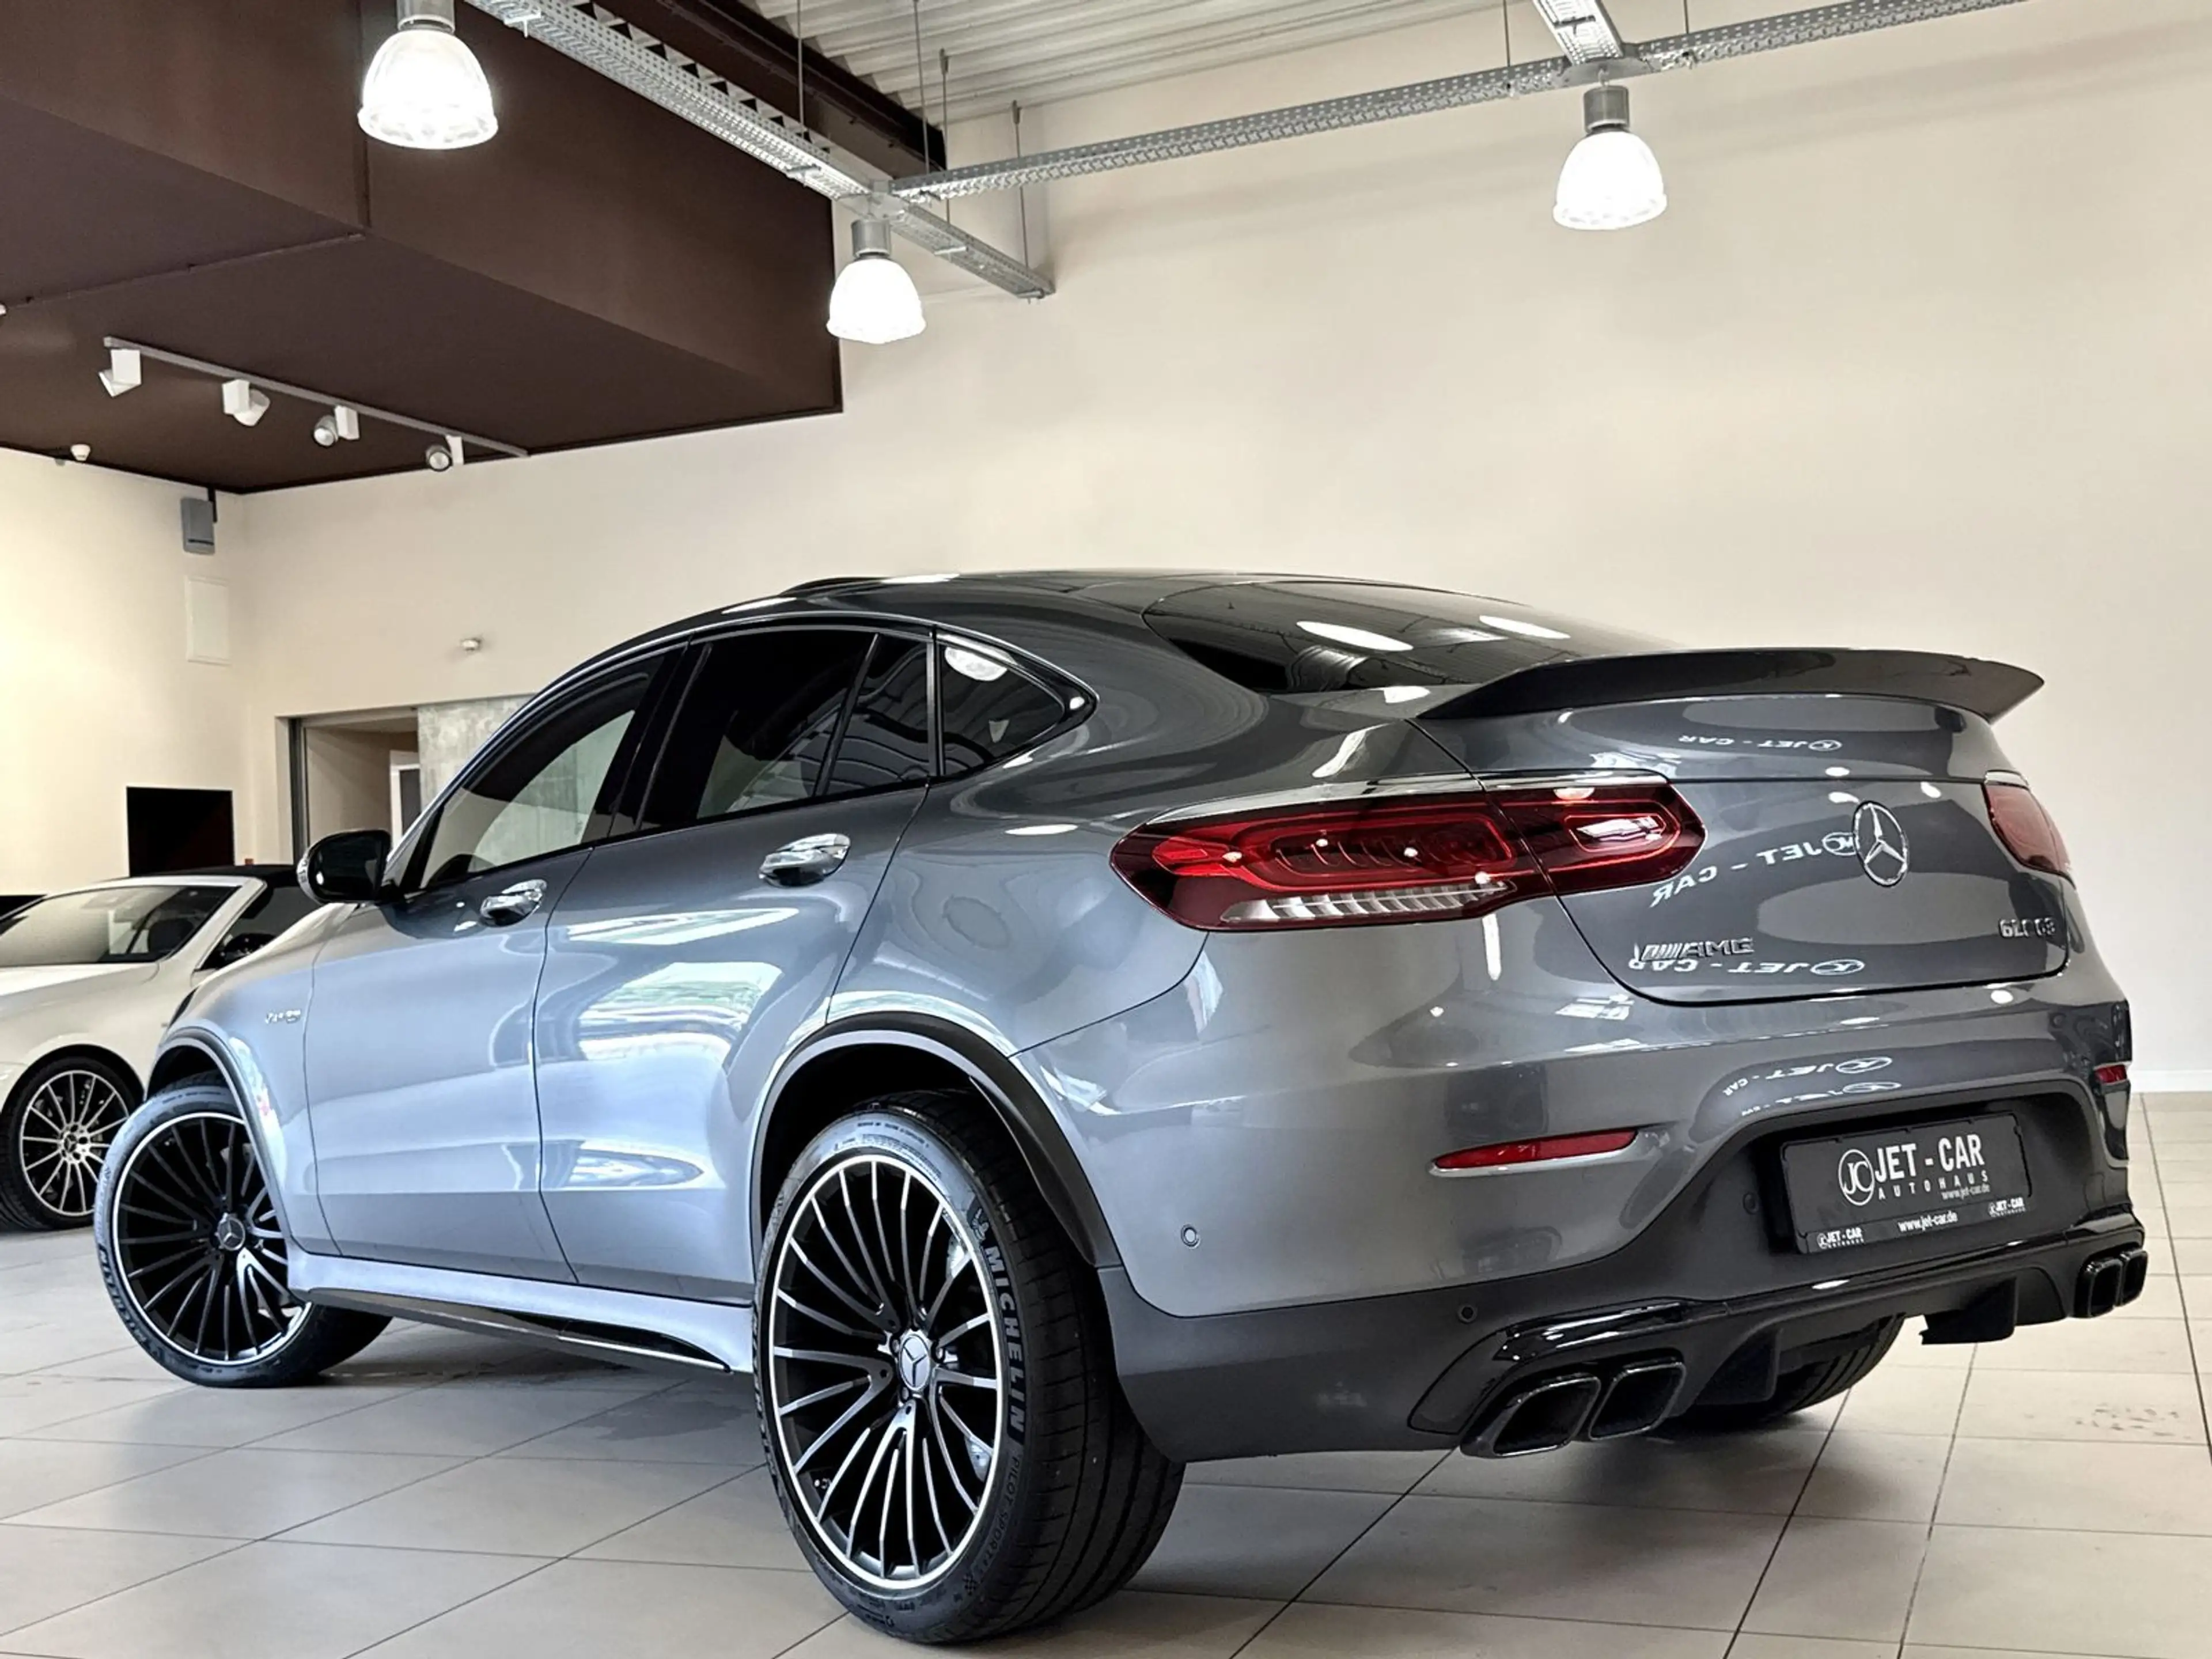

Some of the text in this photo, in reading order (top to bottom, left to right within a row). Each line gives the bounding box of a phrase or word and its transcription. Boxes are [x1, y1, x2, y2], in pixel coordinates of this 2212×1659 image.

[1678, 937, 1755, 959] AMG
[1874, 1143, 1917, 1182] JET
[1938, 1134, 1985, 1172] CAR
[1878, 1169, 1988, 1200] AUTOHAUS
[1897, 1210, 1959, 1232] www.jet-car.de
[984, 1245, 1025, 1433] MICHELIN
[1005, 1455, 1021, 1507] PILOT
